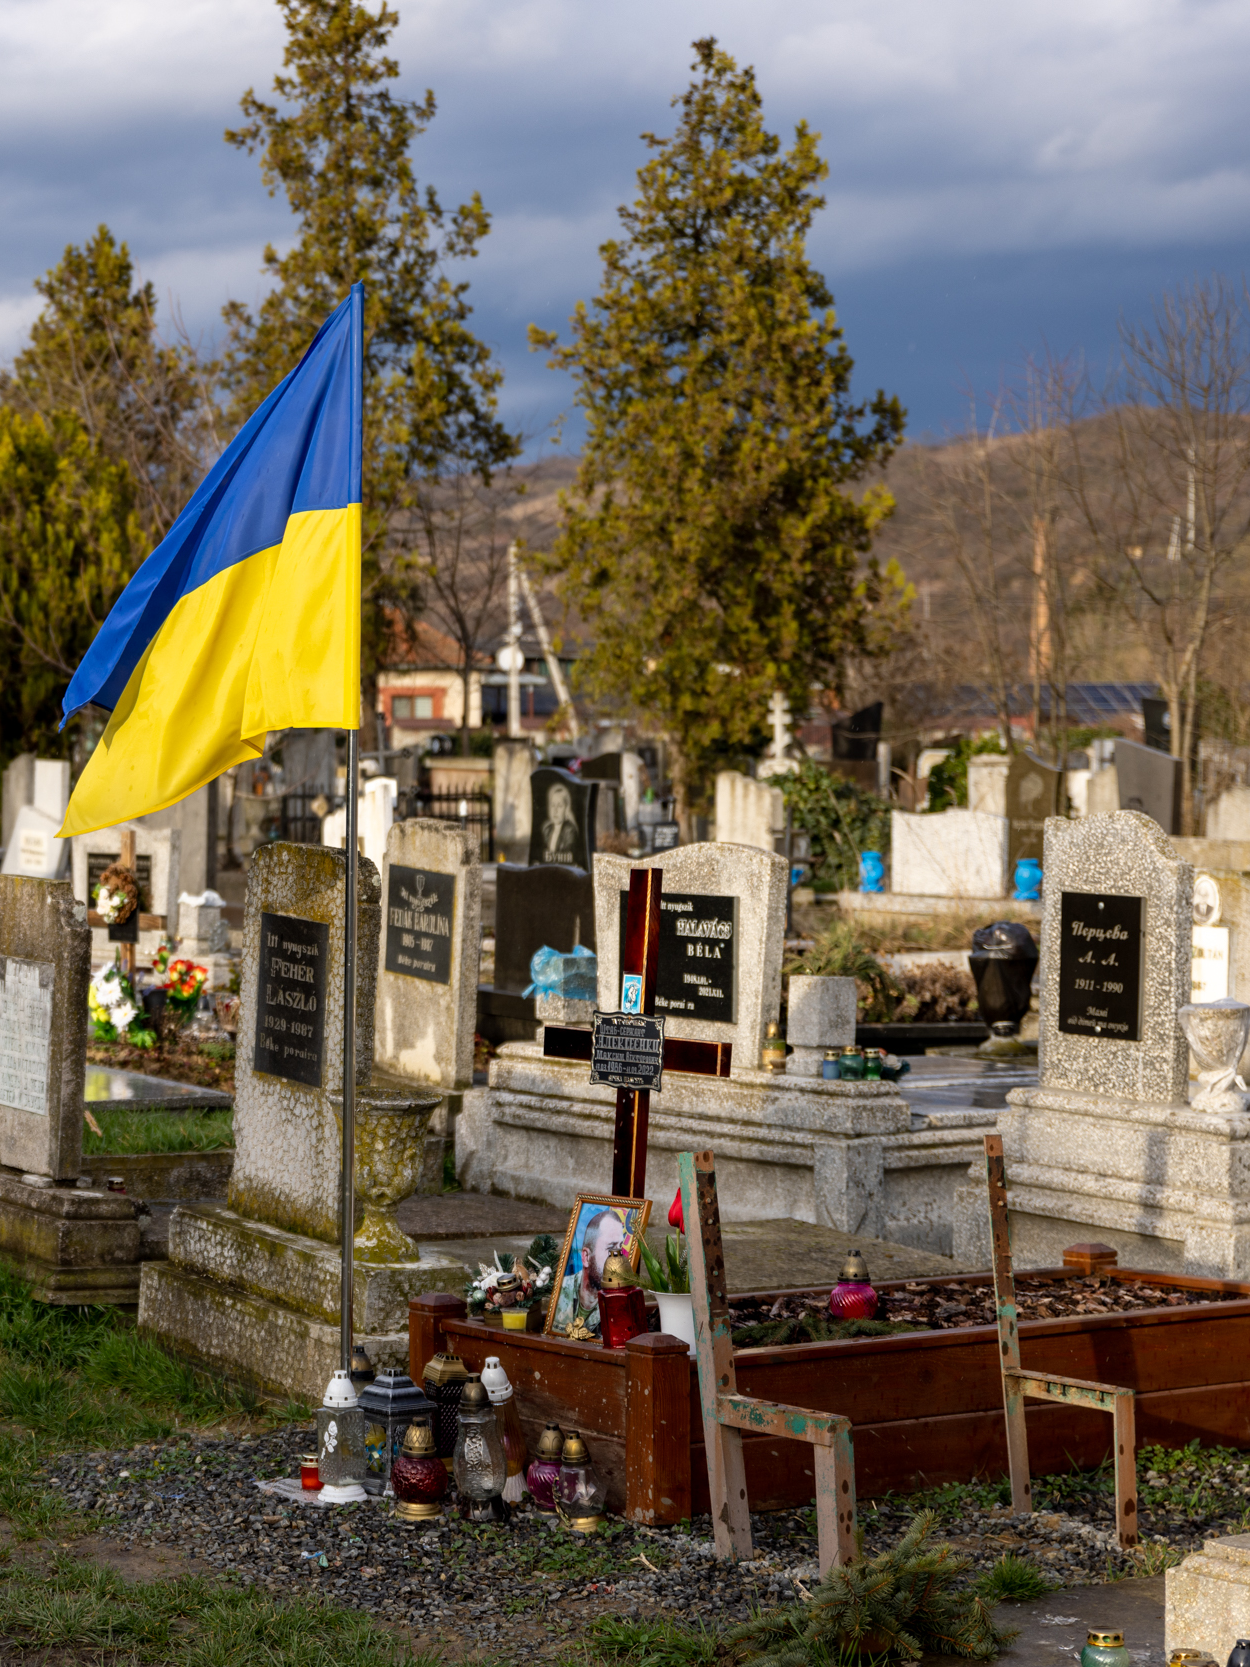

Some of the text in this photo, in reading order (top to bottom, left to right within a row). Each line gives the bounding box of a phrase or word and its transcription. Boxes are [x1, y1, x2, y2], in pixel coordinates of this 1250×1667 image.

[667, 900, 694, 913] nyugszik
[282, 941, 319, 959] nyugszik
[686, 942, 723, 959] BÉLA
[270, 956, 315, 984] FEHÉR
[1074, 978, 1095, 992] 1911
[1102, 980, 1124, 994] 1990
[266, 984, 318, 1012] LÁSZLÓ
